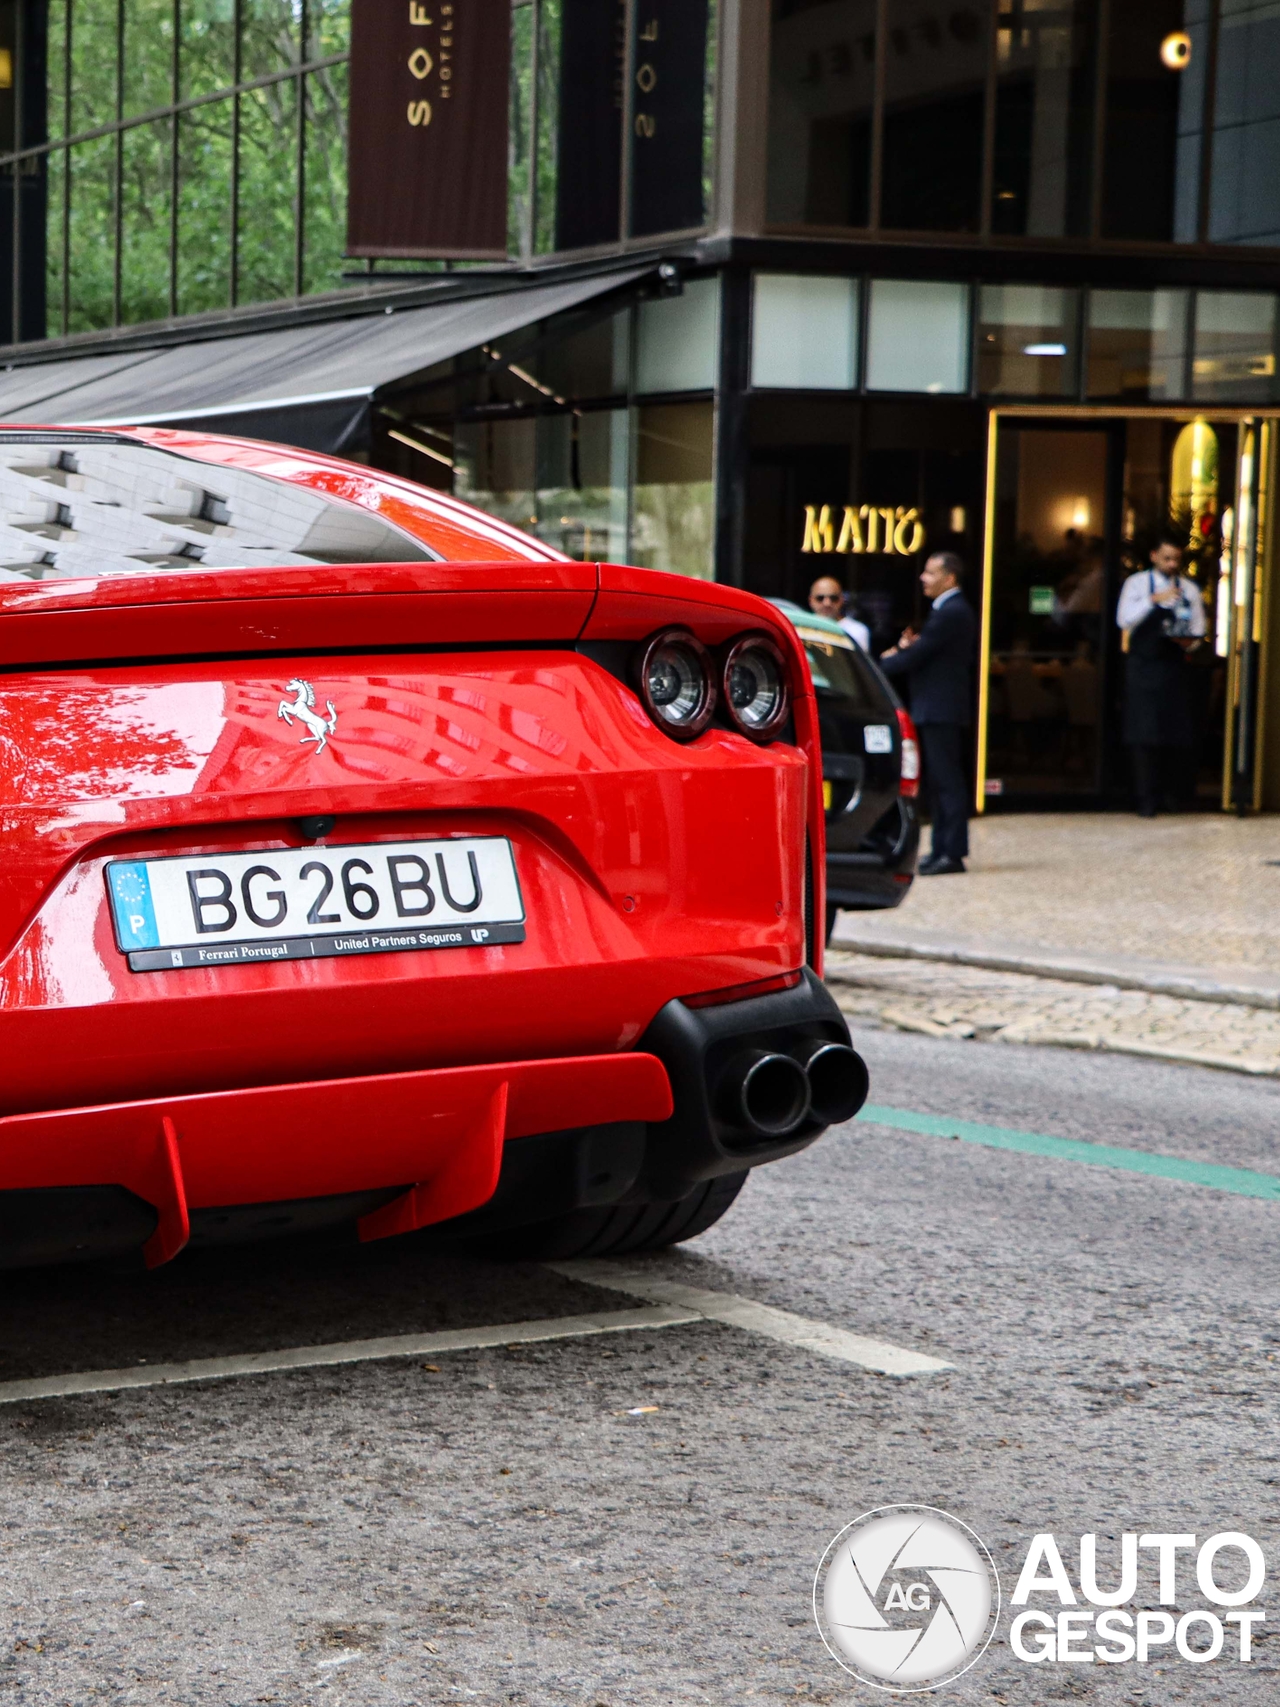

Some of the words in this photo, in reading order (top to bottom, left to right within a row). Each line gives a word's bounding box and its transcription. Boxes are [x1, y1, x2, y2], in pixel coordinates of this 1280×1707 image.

[186, 865, 288, 934] BG
[299, 858, 380, 924] 26
[387, 850, 483, 918] BU
[131, 915, 145, 934] P
[334, 937, 369, 950] United
[372, 935, 417, 947] Partners
[419, 932, 462, 945] Seguros
[199, 948, 239, 960] Ferrari
[240, 944, 288, 958] Portugal
